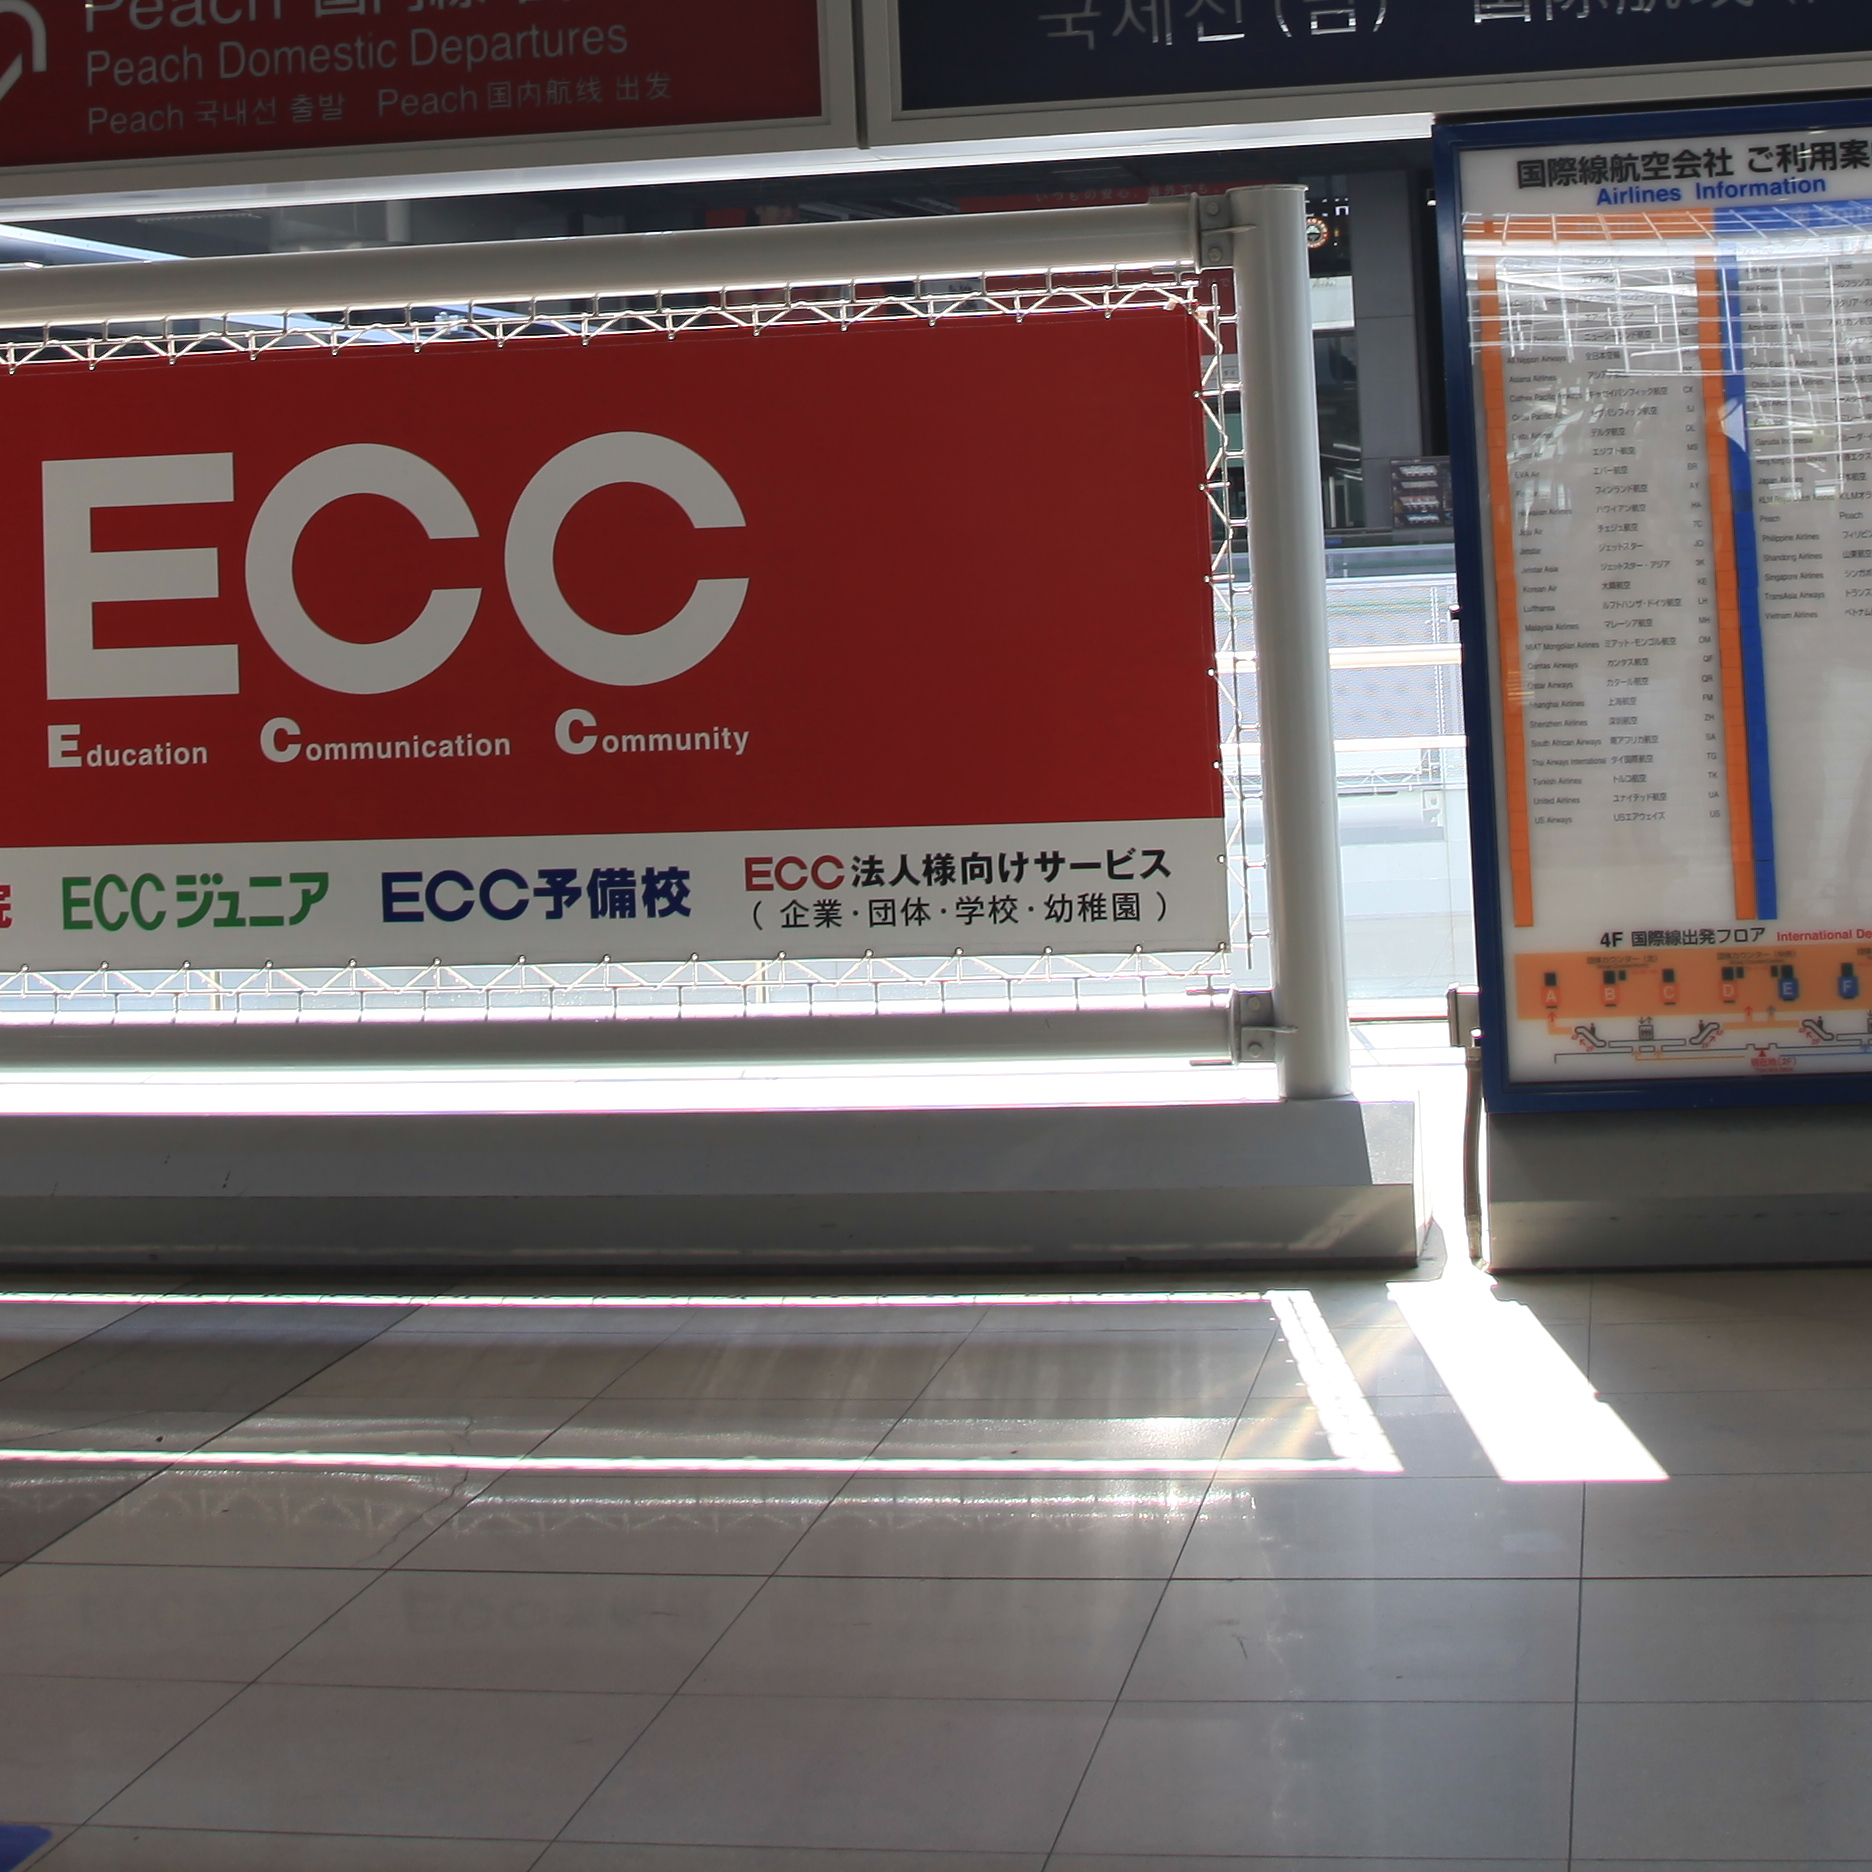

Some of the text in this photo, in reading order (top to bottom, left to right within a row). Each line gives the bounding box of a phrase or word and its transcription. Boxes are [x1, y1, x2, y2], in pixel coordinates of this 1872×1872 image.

[87, 22, 628, 87] Peach Domestic Departures
[88, 101, 184, 135] Peach
[194, 97, 279, 128] 국내선
[290, 93, 345, 122] 출발
[377, 83, 478, 118] Peach
[1517, 147, 1733, 190] 国際線航空会社
[1596, 176, 1826, 206] Airlines Information
[41, 430, 750, 700] ECC
[47, 708, 749, 768] Education Communication Community
[61, 871, 329, 931] ECCジュニア
[381, 866, 692, 924] ECC予備校
[1600, 931, 1623, 948] 4F
[1631, 927, 1766, 947] 国際線出発フロア
[1777, 929, 1852, 942] International
